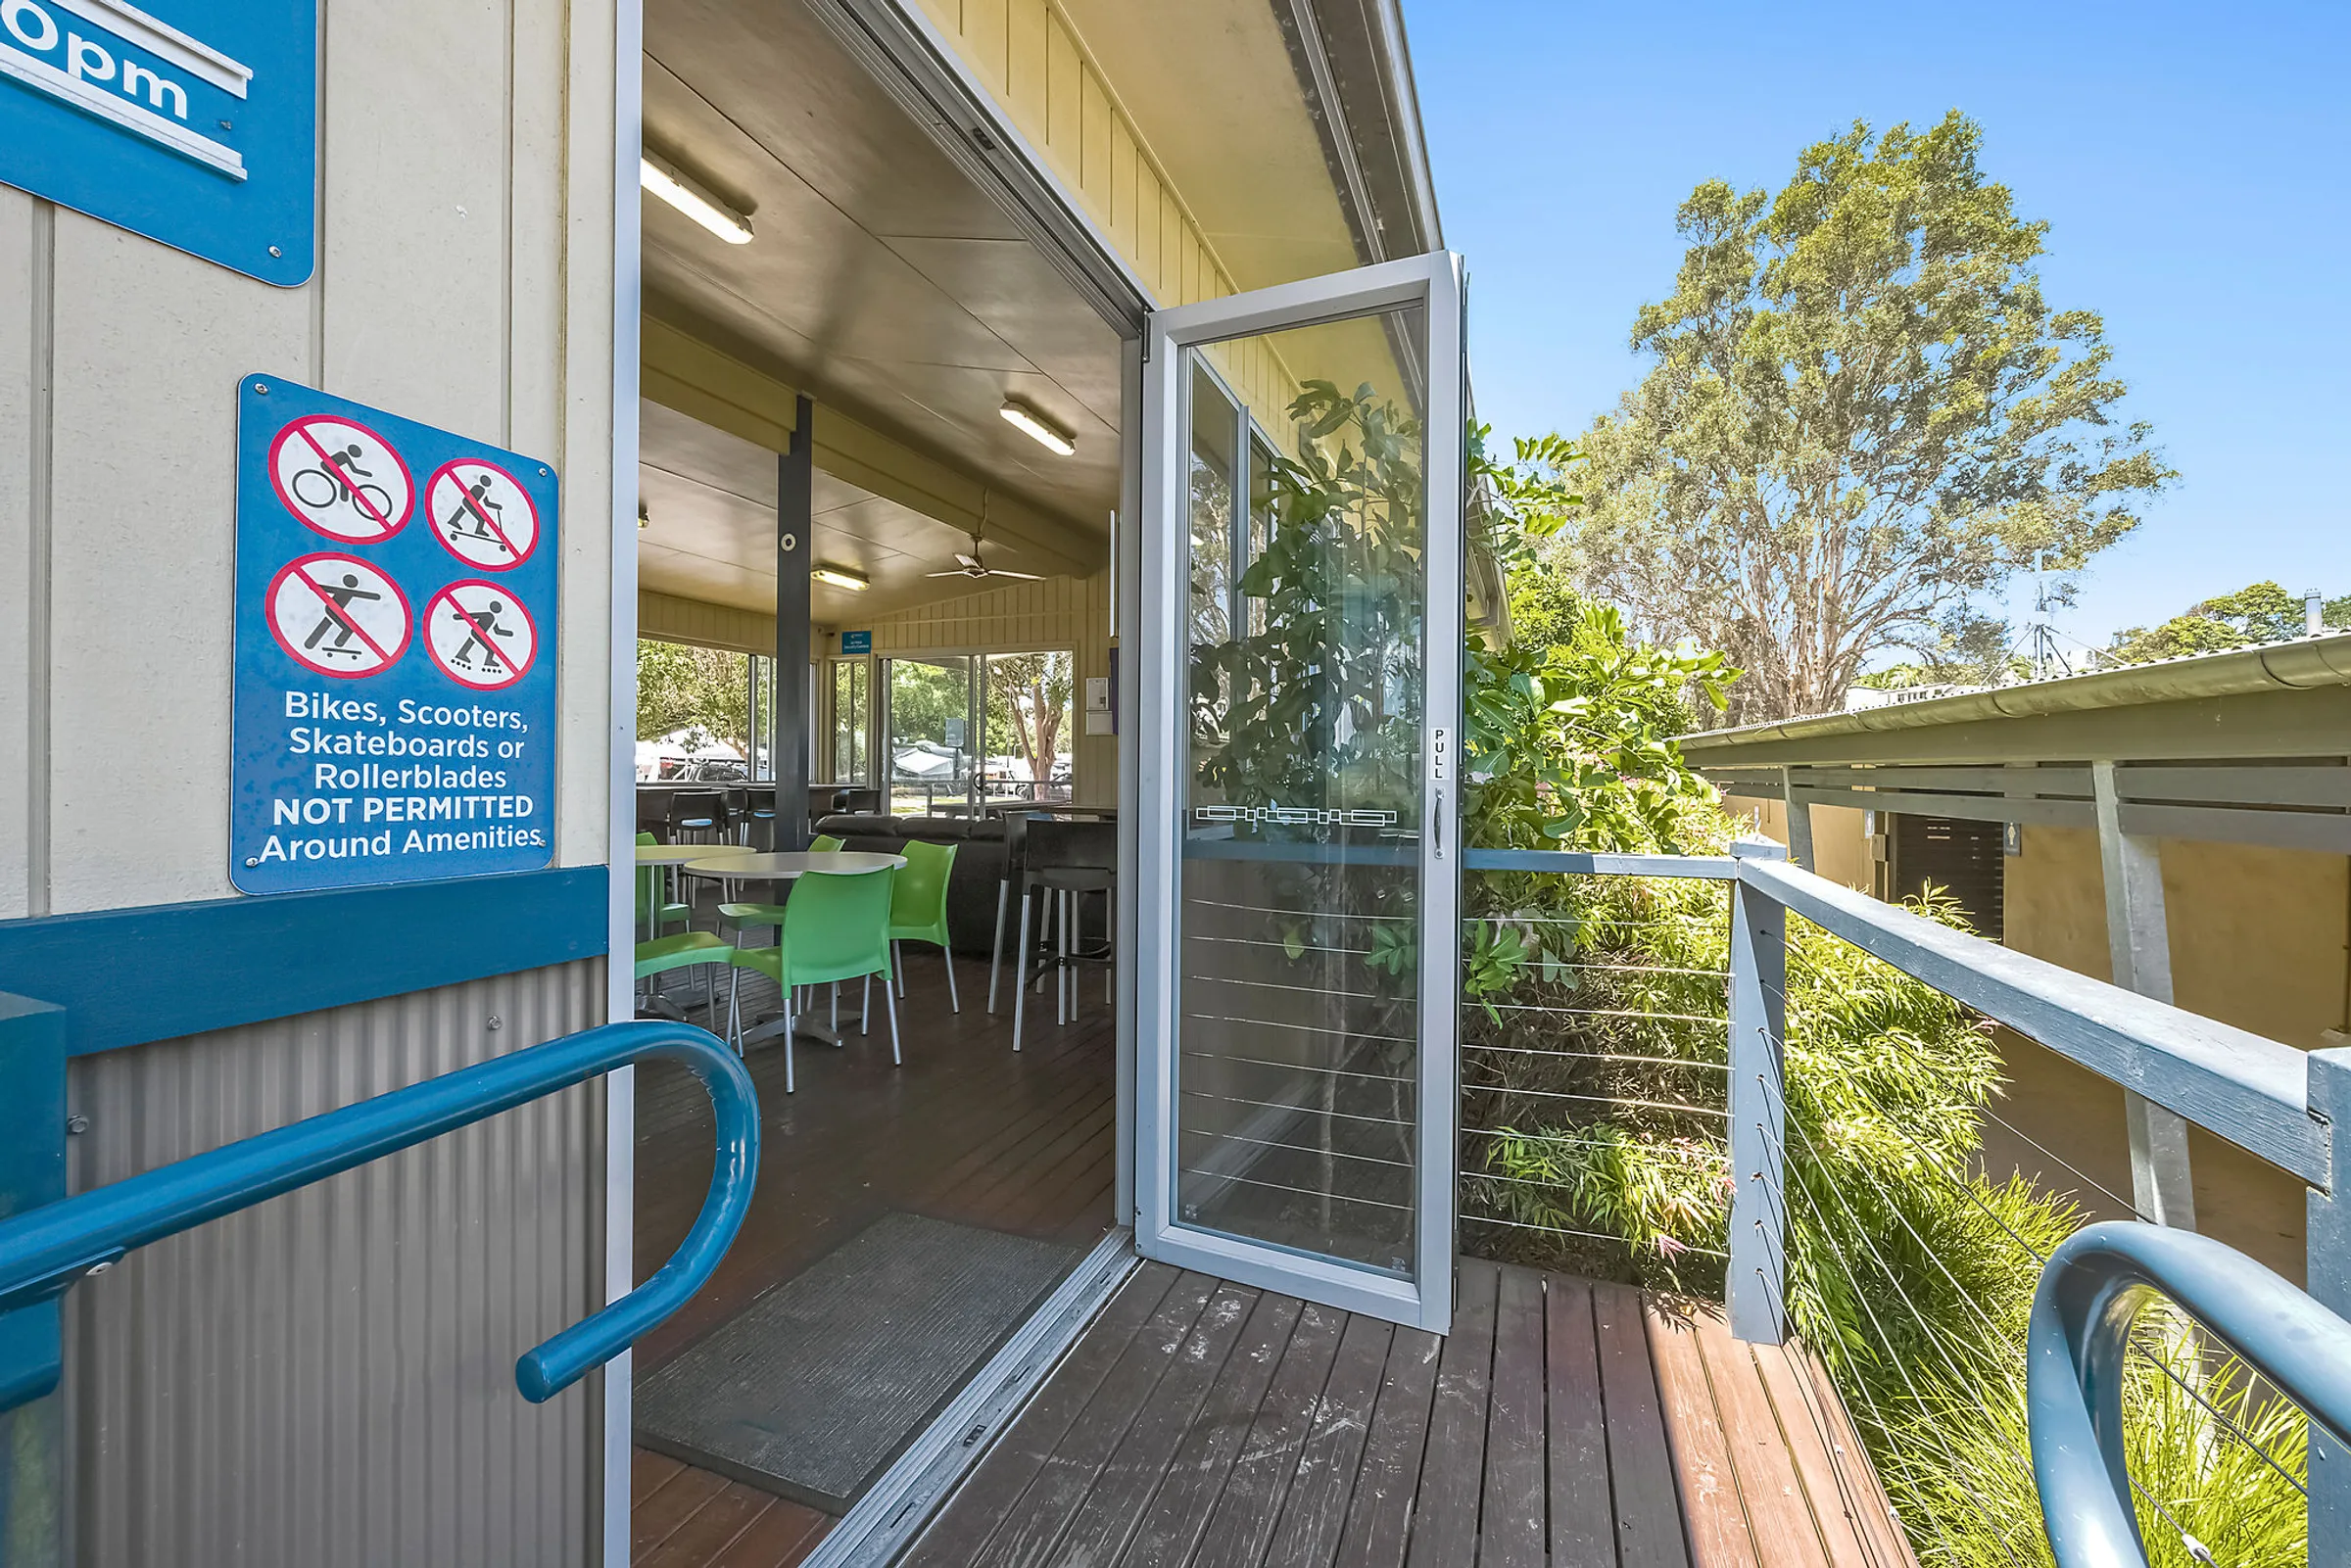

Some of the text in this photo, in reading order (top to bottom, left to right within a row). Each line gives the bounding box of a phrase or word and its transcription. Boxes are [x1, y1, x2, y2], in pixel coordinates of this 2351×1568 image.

[285, 690, 528, 733] Bikes, Scooters,
[290, 728, 524, 759] Skateboards or
[1435, 730, 1444, 779] PULL
[315, 763, 506, 789] Rollerblades
[273, 795, 533, 826] NOT PERMITTED
[259, 825, 541, 863] Around Amenities
